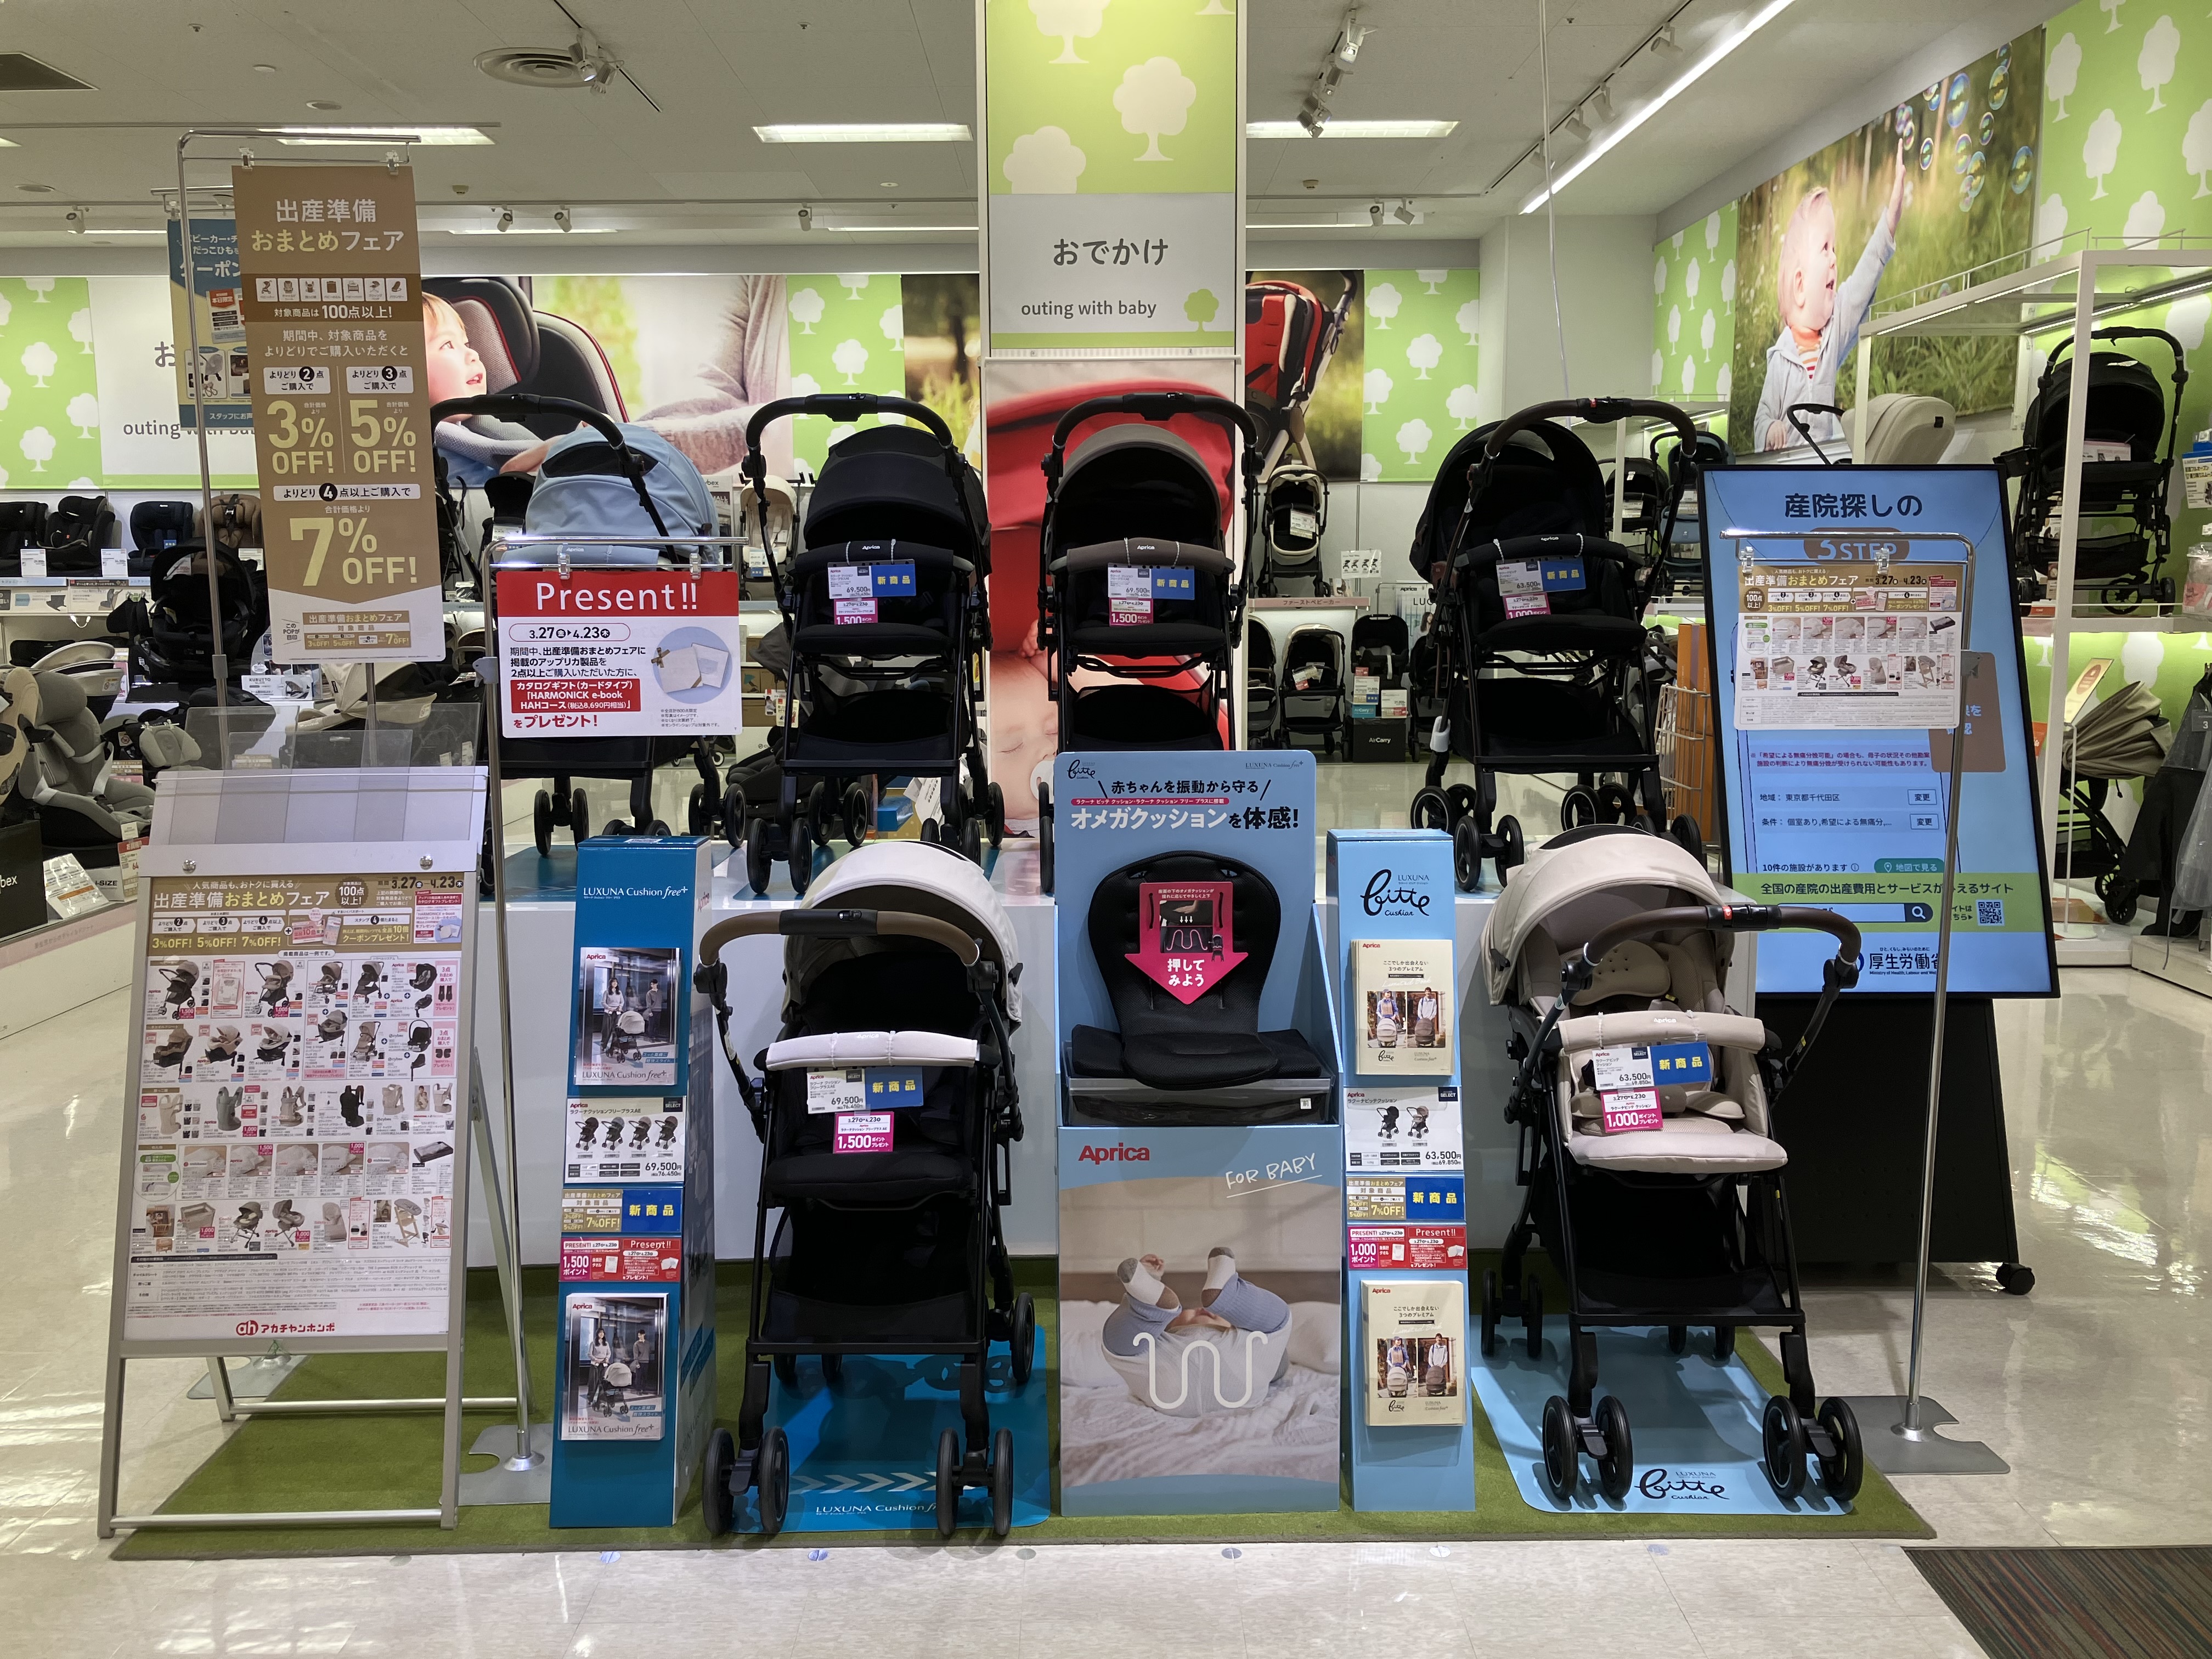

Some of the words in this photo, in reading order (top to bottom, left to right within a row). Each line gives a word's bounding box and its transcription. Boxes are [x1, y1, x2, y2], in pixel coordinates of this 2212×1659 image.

[276, 199, 376, 223] 出産準備
[252, 229, 404, 252] おまとめフェア
[1054, 238, 1168, 265] おでかけ
[1022, 302, 1074, 319] outing
[1079, 300, 1113, 315] with
[1119, 301, 1156, 318] baby
[283, 330, 387, 341] 期間中、対象商品を
[265, 346, 408, 357] よりどりでご購入いただくと
[269, 366, 324, 382] よりどり2点
[352, 366, 407, 381] よりどり3点
[281, 382, 313, 391] ご購入で
[364, 381, 396, 390] ご購入で
[123, 420, 180, 439] outing
[267, 400, 334, 449] 3%
[349, 400, 416, 448] 5%
[272, 452, 334, 474] OFF!
[353, 450, 416, 473] OFF!
[283, 483, 410, 501] よりどり4点以上ご購入で
[1785, 494, 1922, 518] 産院探しの
[290, 517, 377, 586] 7%
[342, 557, 416, 585] OFF!
[1745, 575, 1858, 586] 出産準備おまとめフェア
[537, 583, 697, 610] Present!!
[309, 614, 402, 623] 出産準備おまとめフェア
[1111, 613, 1137, 623] 1,500
[510, 647, 645, 656] 期間中、出産準備おまとめフェアに
[511, 658, 606, 667] 掲載のアップリカ製品を
[511, 669, 637, 677] 2点以上ご購入いただいた方に、
[517, 681, 632, 690] カタログギフト(カードタイプ)
[514, 715, 597, 728] をプレゼント!
[1111, 780, 1259, 794] 赤ちゃんを振動から守る
[1071, 806, 1299, 831] オメガクッションを体感!
[1763, 864, 1848, 872] 10件の施設があります
[1896, 863, 1938, 872] 地図で見る
[193, 881, 294, 890] 人気商品も、おトクに買える
[339, 887, 364, 896] 100点
[1761, 883, 2013, 895] 全国の産院の出産費用とサービスがえるサイト
[583, 888, 624, 896] LUXUNA
[627, 888, 662, 896] Cushion
[154, 891, 330, 909] 出産準備おまとめフェア
[342, 897, 362, 905] 以上!
[153, 938, 191, 948] 3%OFF!
[197, 937, 236, 947] 5%OFF!
[242, 936, 281, 946] 7%OFF!
[343, 934, 409, 943] クーポンプレゼント!
[1167, 958, 1204, 972] 押して
[1168, 974, 1204, 987] みよう
[1659, 1057, 1702, 1070] 新商品
[1619, 1073, 1651, 1081] 63,500円
[873, 1080, 916, 1093] 新商品
[831, 1096, 863, 1105] 69,500円
[1606, 1113, 1639, 1127] 1,000
[838, 1135, 871, 1149] 1,500
[1079, 1142, 1149, 1165] Aprica
[1425, 1151, 1461, 1159] 63,500円
[645, 1163, 681, 1171] 69,500円
[1225, 1169, 1257, 1189] FOR
[1266, 1153, 1316, 1180] BABY
[1413, 1192, 1457, 1204] 新商品
[629, 1204, 674, 1216] 新商品
[1372, 1205, 1404, 1216] 7%OFF!
[586, 1217, 620, 1228] 7%OFF!
[1351, 1244, 1376, 1256] 1,000
[563, 1256, 589, 1268] 1,500
[261, 1323, 335, 1334] アカチャンホンポ
[603, 1425, 633, 1433] Cushion
